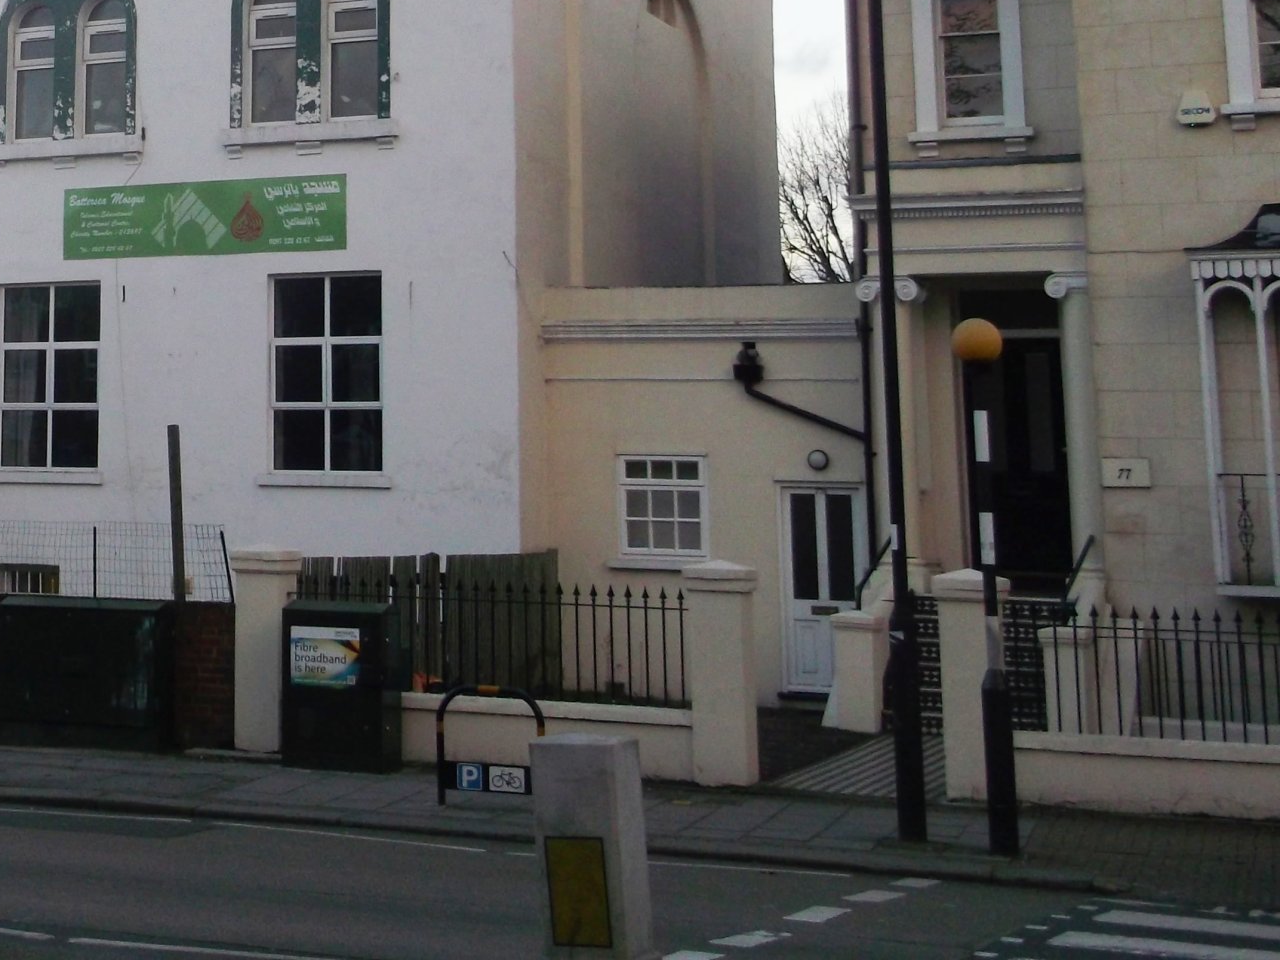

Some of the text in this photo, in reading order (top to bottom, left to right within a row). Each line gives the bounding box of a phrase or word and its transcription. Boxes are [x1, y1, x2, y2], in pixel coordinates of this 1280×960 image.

[69, 192, 145, 207] Battersea Mosque
[1117, 468, 1131, 479] 77
[294, 640, 318, 652] Fibre
[294, 653, 347, 664] broadband
[294, 663, 326, 673] is here
[462, 765, 478, 787] P
